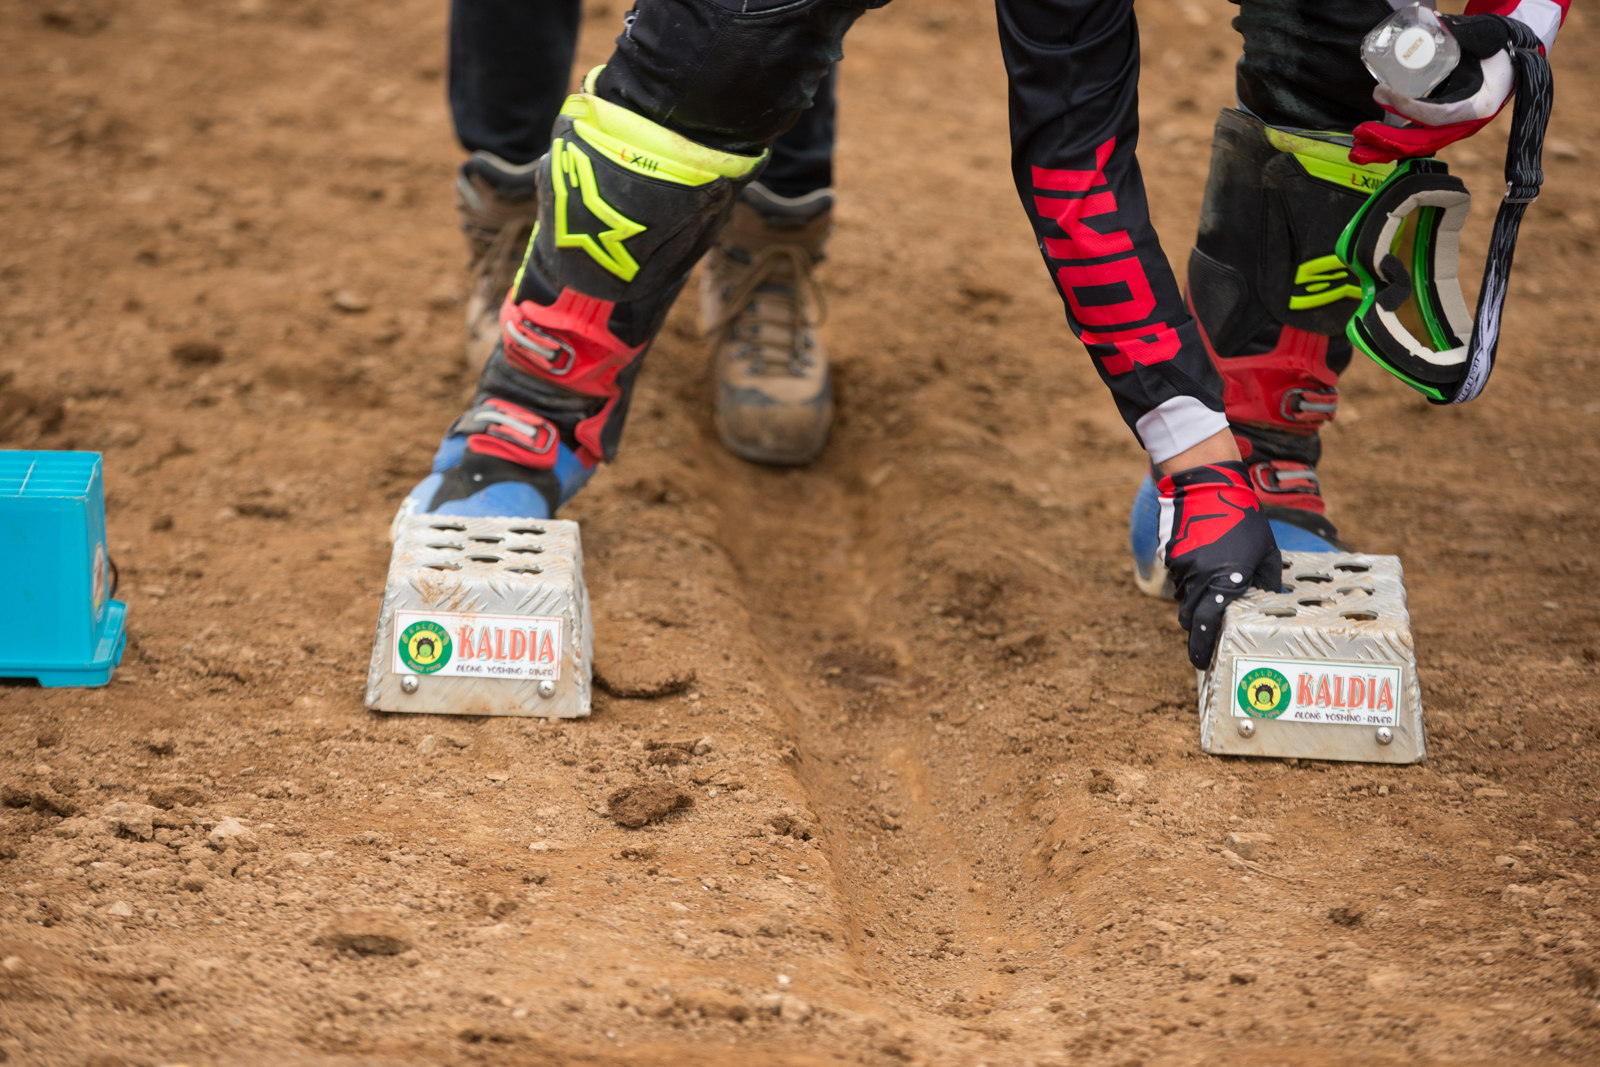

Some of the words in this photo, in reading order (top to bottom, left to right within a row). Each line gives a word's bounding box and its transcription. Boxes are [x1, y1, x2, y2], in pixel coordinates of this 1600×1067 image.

[621, 148, 659, 173] LXIII
[457, 625, 556, 664] KALDIA
[456, 665, 483, 673] ALONG
[487, 666, 523, 675] YOSHINO
[1247, 669, 1282, 683] KALDIA
[1296, 672, 1394, 712] KALDIA
[1295, 711, 1321, 720] ALONG
[1325, 713, 1361, 722] YOSHINO
[1367, 715, 1392, 724] RIVER
